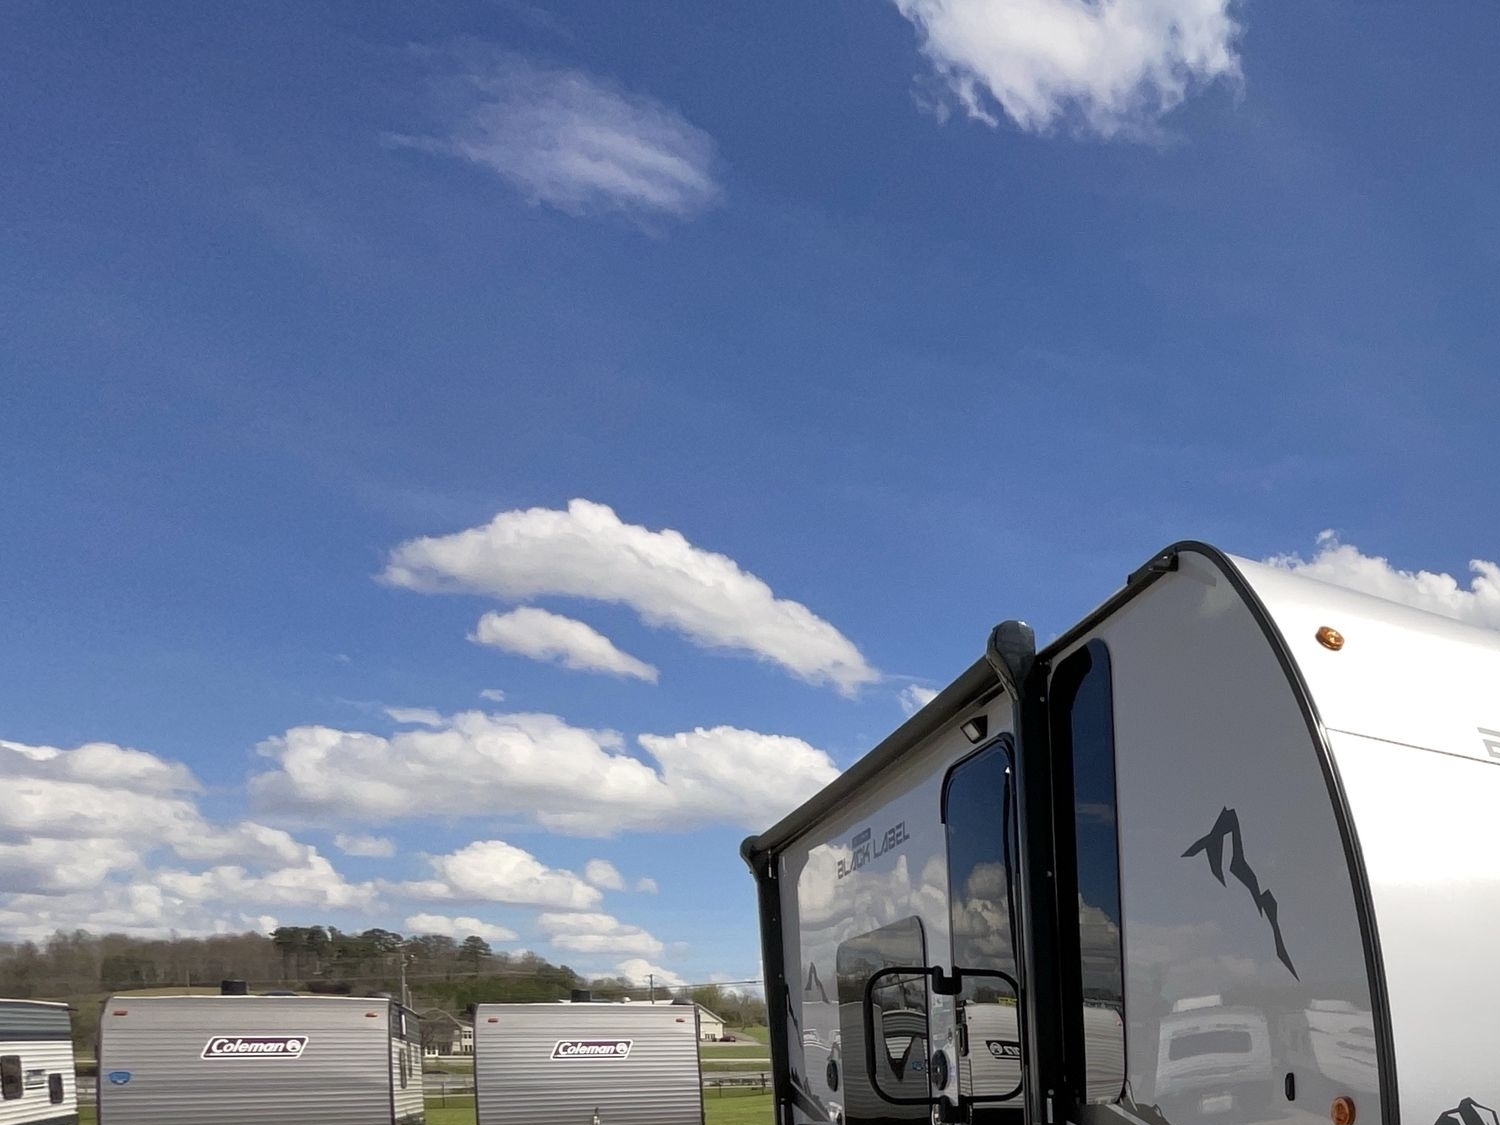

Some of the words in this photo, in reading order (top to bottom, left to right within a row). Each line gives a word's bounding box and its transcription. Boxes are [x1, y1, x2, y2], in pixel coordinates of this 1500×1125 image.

[837, 842, 871, 879] BLACK
[873, 820, 910, 859] LABEL
[211, 1038, 285, 1054] Coleman
[558, 1042, 616, 1055] Coleman
